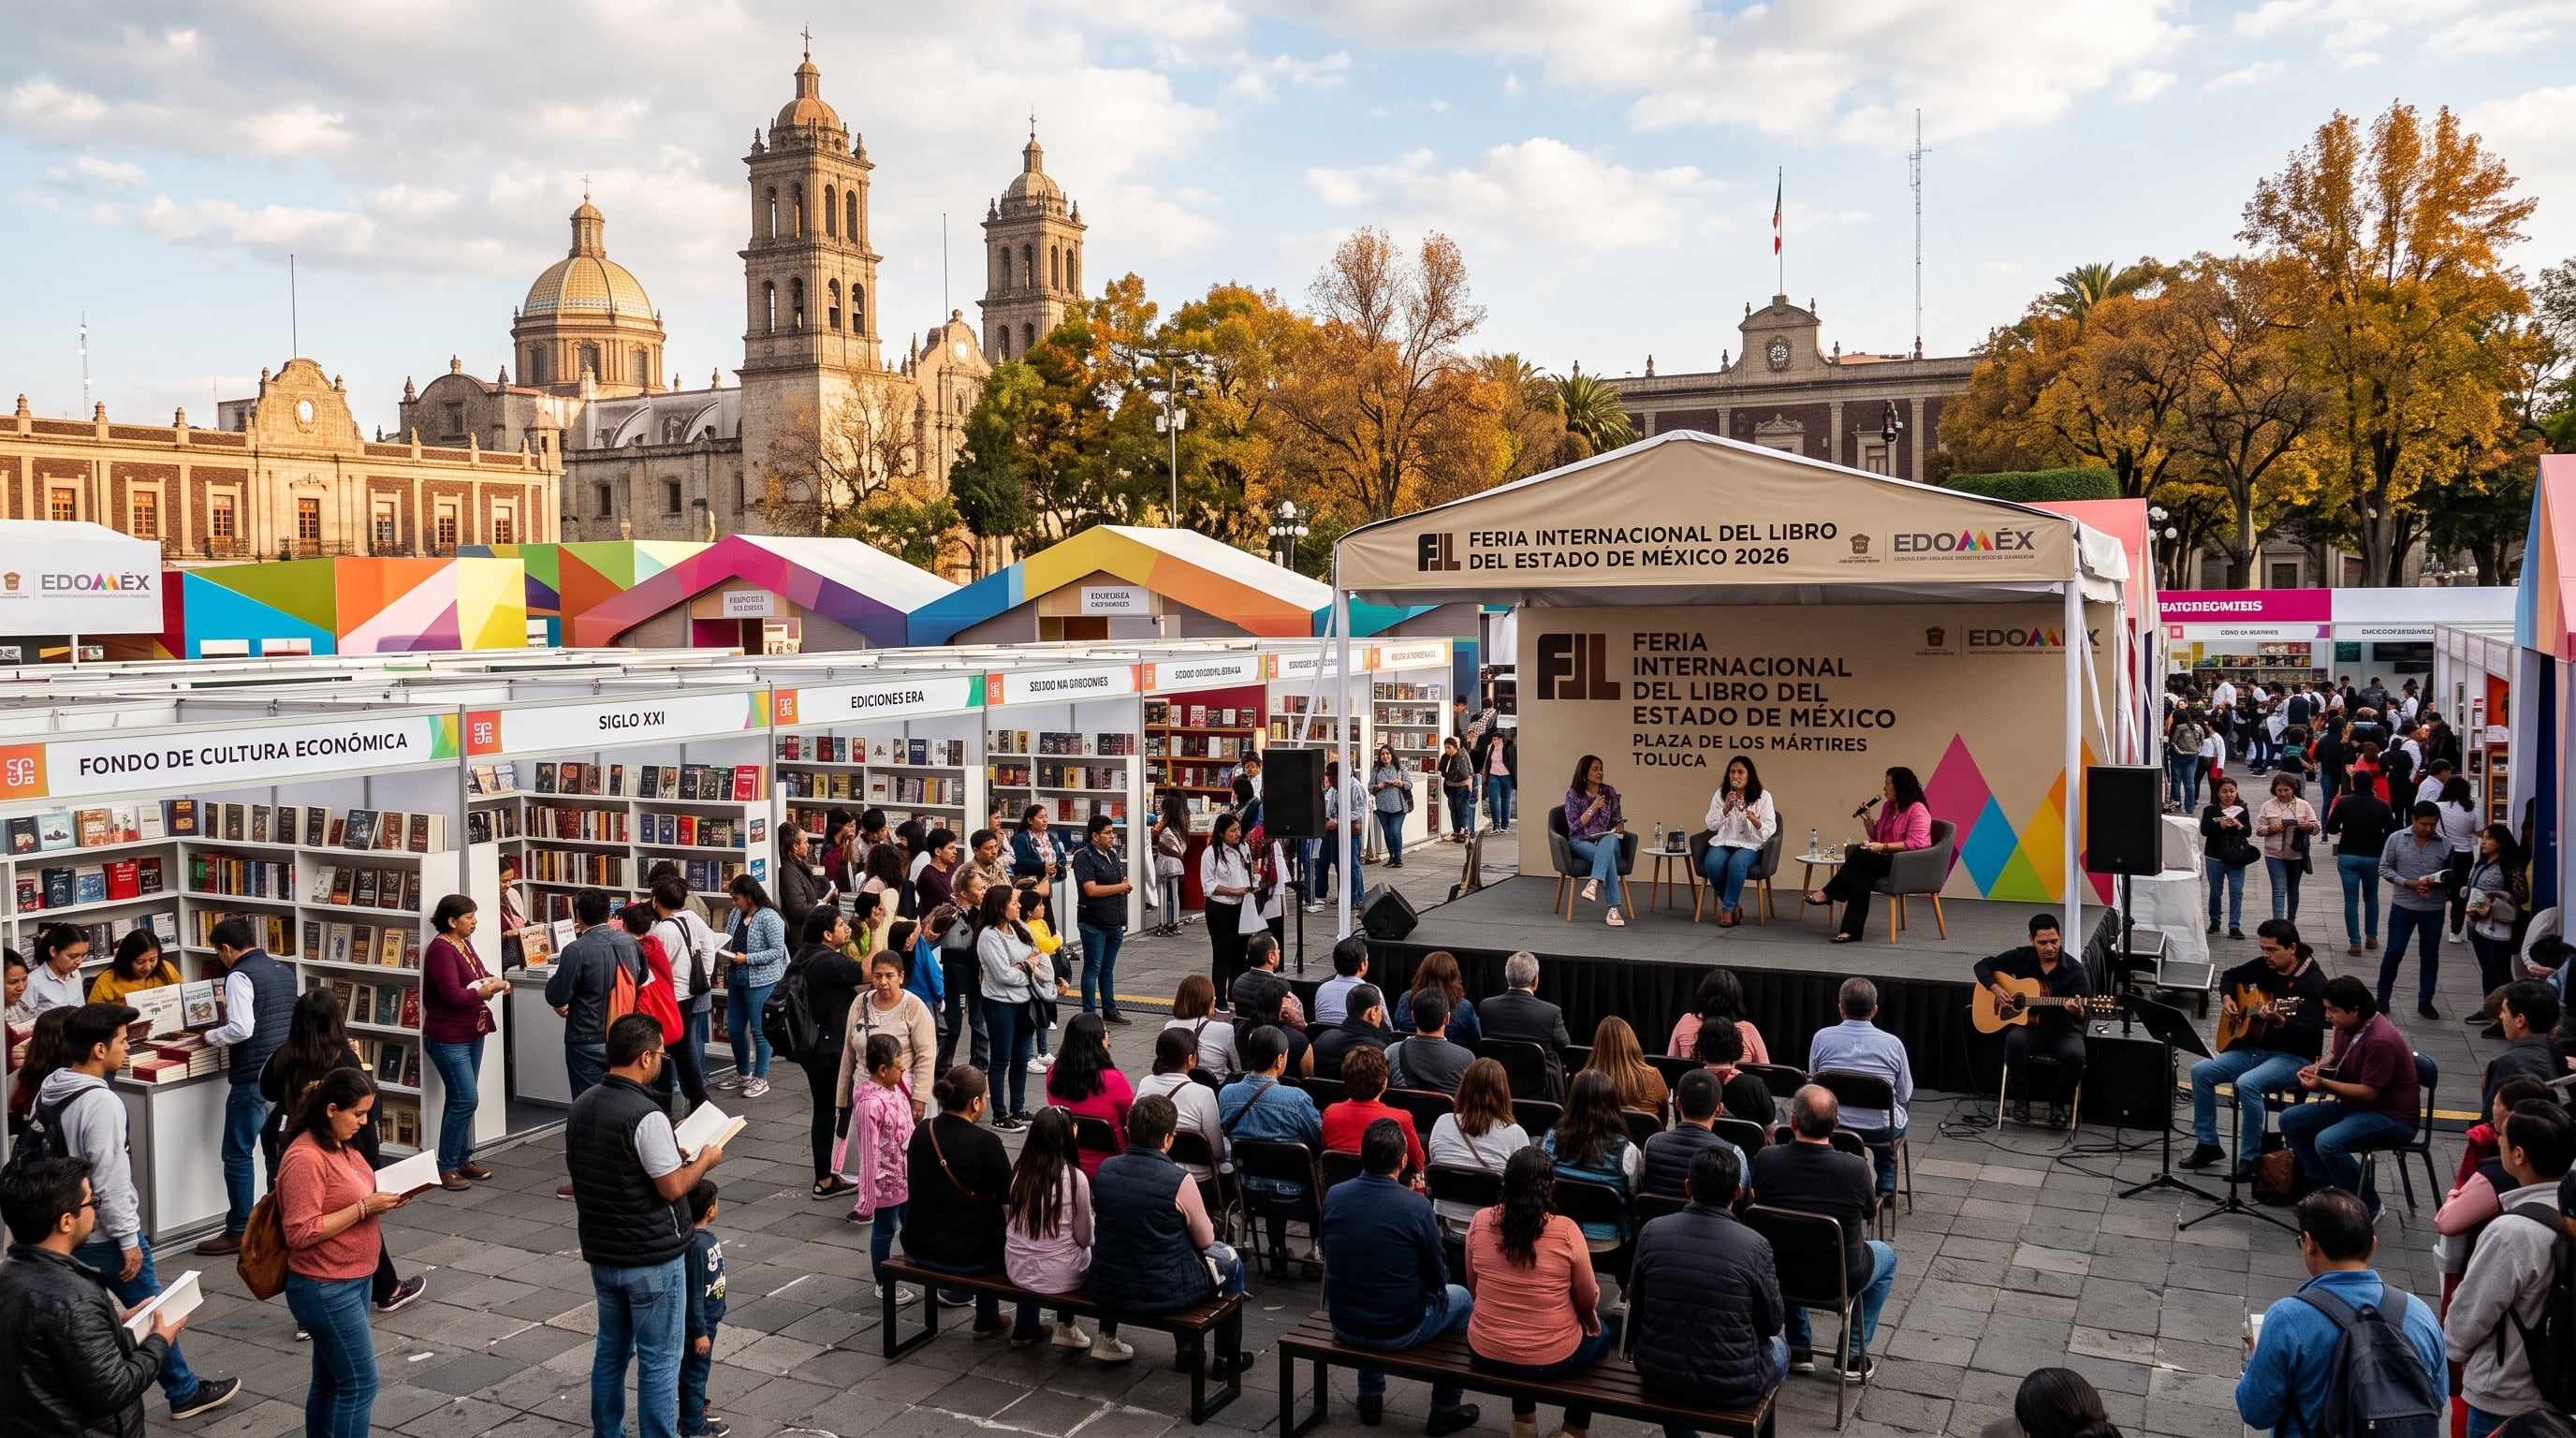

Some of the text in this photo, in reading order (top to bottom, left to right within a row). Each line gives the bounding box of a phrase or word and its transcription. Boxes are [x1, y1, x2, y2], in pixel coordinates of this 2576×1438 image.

[1470, 522, 1837, 547] FERIA INTERNACIONAL DEL LIBRO
[1894, 527, 2035, 551] EDOMÉX
[1470, 545, 1789, 569] DEL ESTADO DE MÉXICO 2026
[1633, 632, 1707, 652] FERIA
[1633, 656, 1852, 677] INTERNACIONAL
[851, 690, 924, 708] EDICIONES ERA
[1633, 682, 1828, 702] DEL LIBRO DEL
[599, 711, 664, 729] SIGLO XXI
[1633, 704, 1895, 728] ESTADO DE MÉXICO
[1633, 733, 1867, 752] PLAZA DE LOS MÁRTIRES
[80, 732, 407, 775] FONDO DE CULTURA ECONÓMICA
[1632, 752, 1706, 767] TOLUCA
